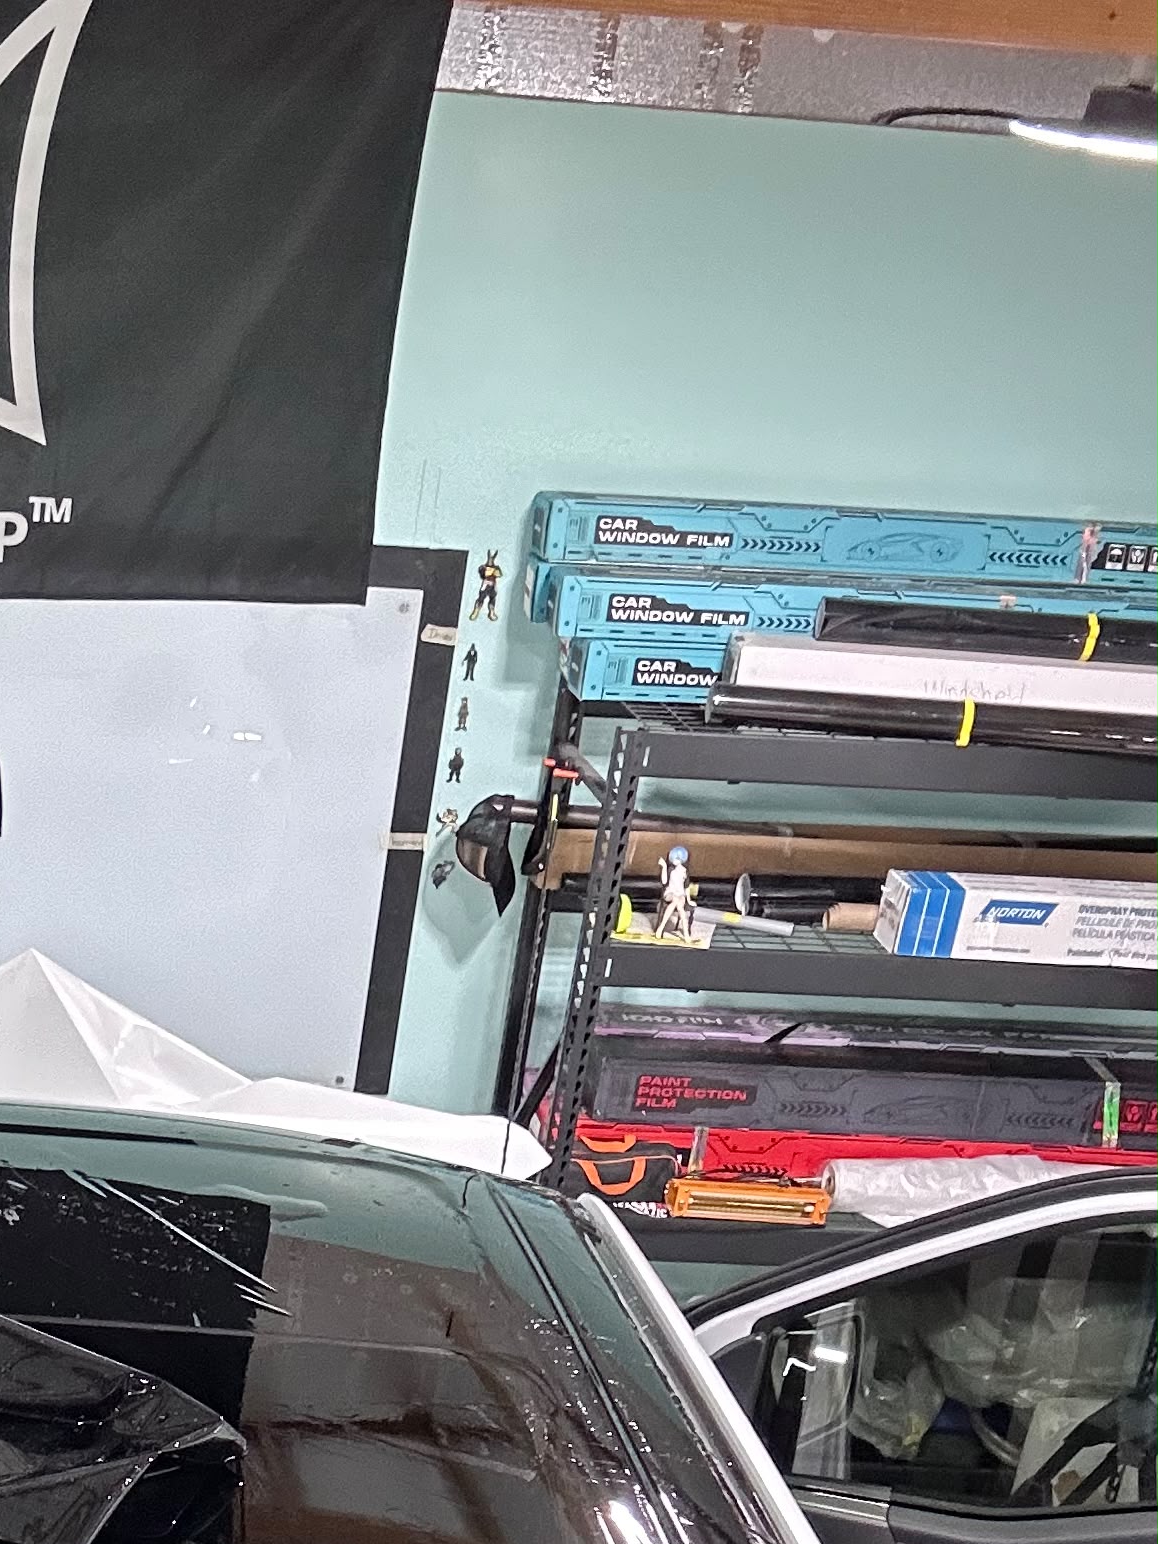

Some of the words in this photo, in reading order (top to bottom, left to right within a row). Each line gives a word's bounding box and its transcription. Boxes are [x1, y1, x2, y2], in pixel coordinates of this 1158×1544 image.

[599, 518, 638, 530] CAR
[598, 531, 680, 545] WINDOW
[686, 535, 730, 547] FILM
[611, 596, 651, 608] CAR
[611, 609, 694, 623] WINDOW
[700, 613, 745, 626] FILM
[637, 660, 677, 672] CAR
[636, 673, 718, 686] WINDOW
[987, 906, 1045, 920] NORTON
[1078, 904, 1129, 915] OVERSPRAY
[1123, 918, 1135, 928] DE
[639, 1076, 691, 1087] PAINT
[637, 1086, 747, 1101] PROTECTION
[635, 1097, 677, 1108] FILM
